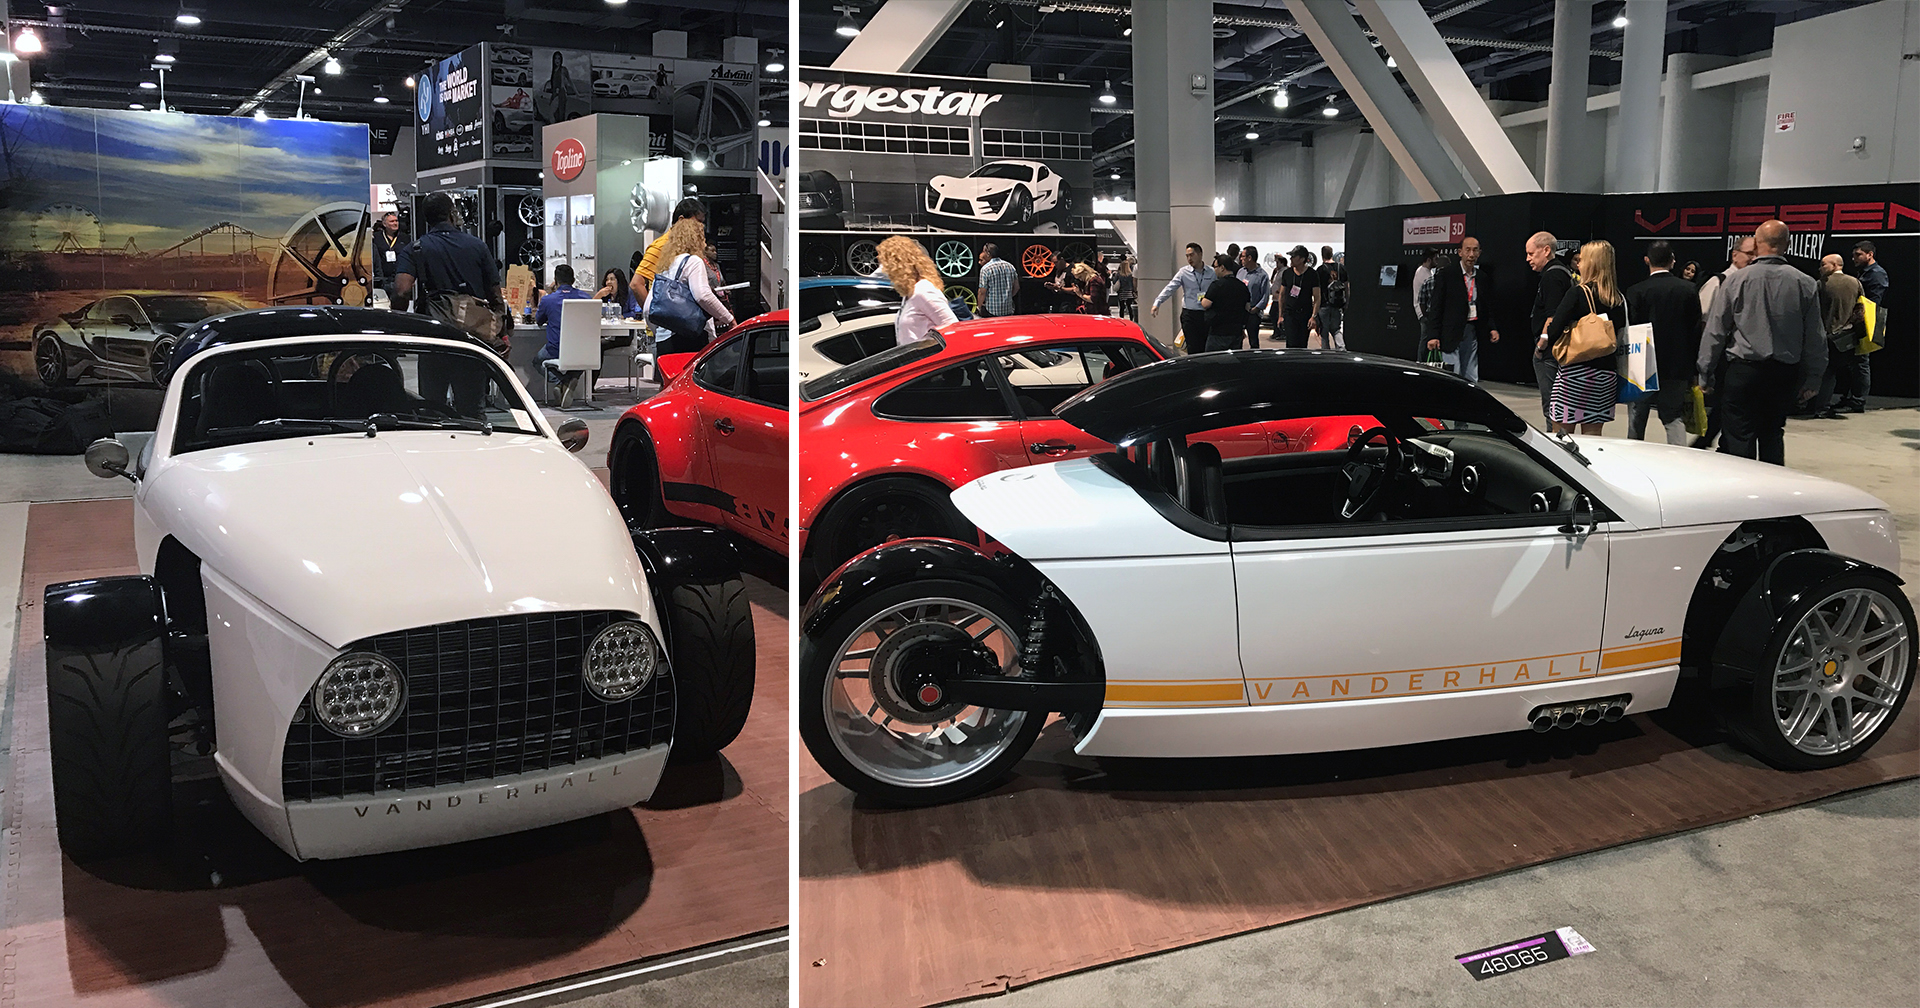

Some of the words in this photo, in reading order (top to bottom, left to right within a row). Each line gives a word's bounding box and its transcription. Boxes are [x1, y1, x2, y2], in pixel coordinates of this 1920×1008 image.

[439, 80, 447, 92] THE
[447, 66, 468, 90] WORLD
[711, 64, 753, 80] Advanti
[440, 93, 444, 103] IS
[444, 89, 452, 102] OUR
[452, 80, 477, 104] MARKET
[1777, 111, 1795, 120] FIRE
[555, 148, 583, 175] Topline
[1407, 226, 1446, 236] VOSSEN
[1452, 222, 1464, 236] 3D
[1635, 202, 1920, 233] VOSSEN
[1404, 248, 1423, 256] VIRTU
[1784, 233, 1826, 260] ALLERY
[1624, 625, 1665, 641] Laguna
[1254, 655, 1592, 701] VANDERHALL
[354, 765, 622, 818] VANDERHALL
[1480, 946, 1549, 974] 46065
